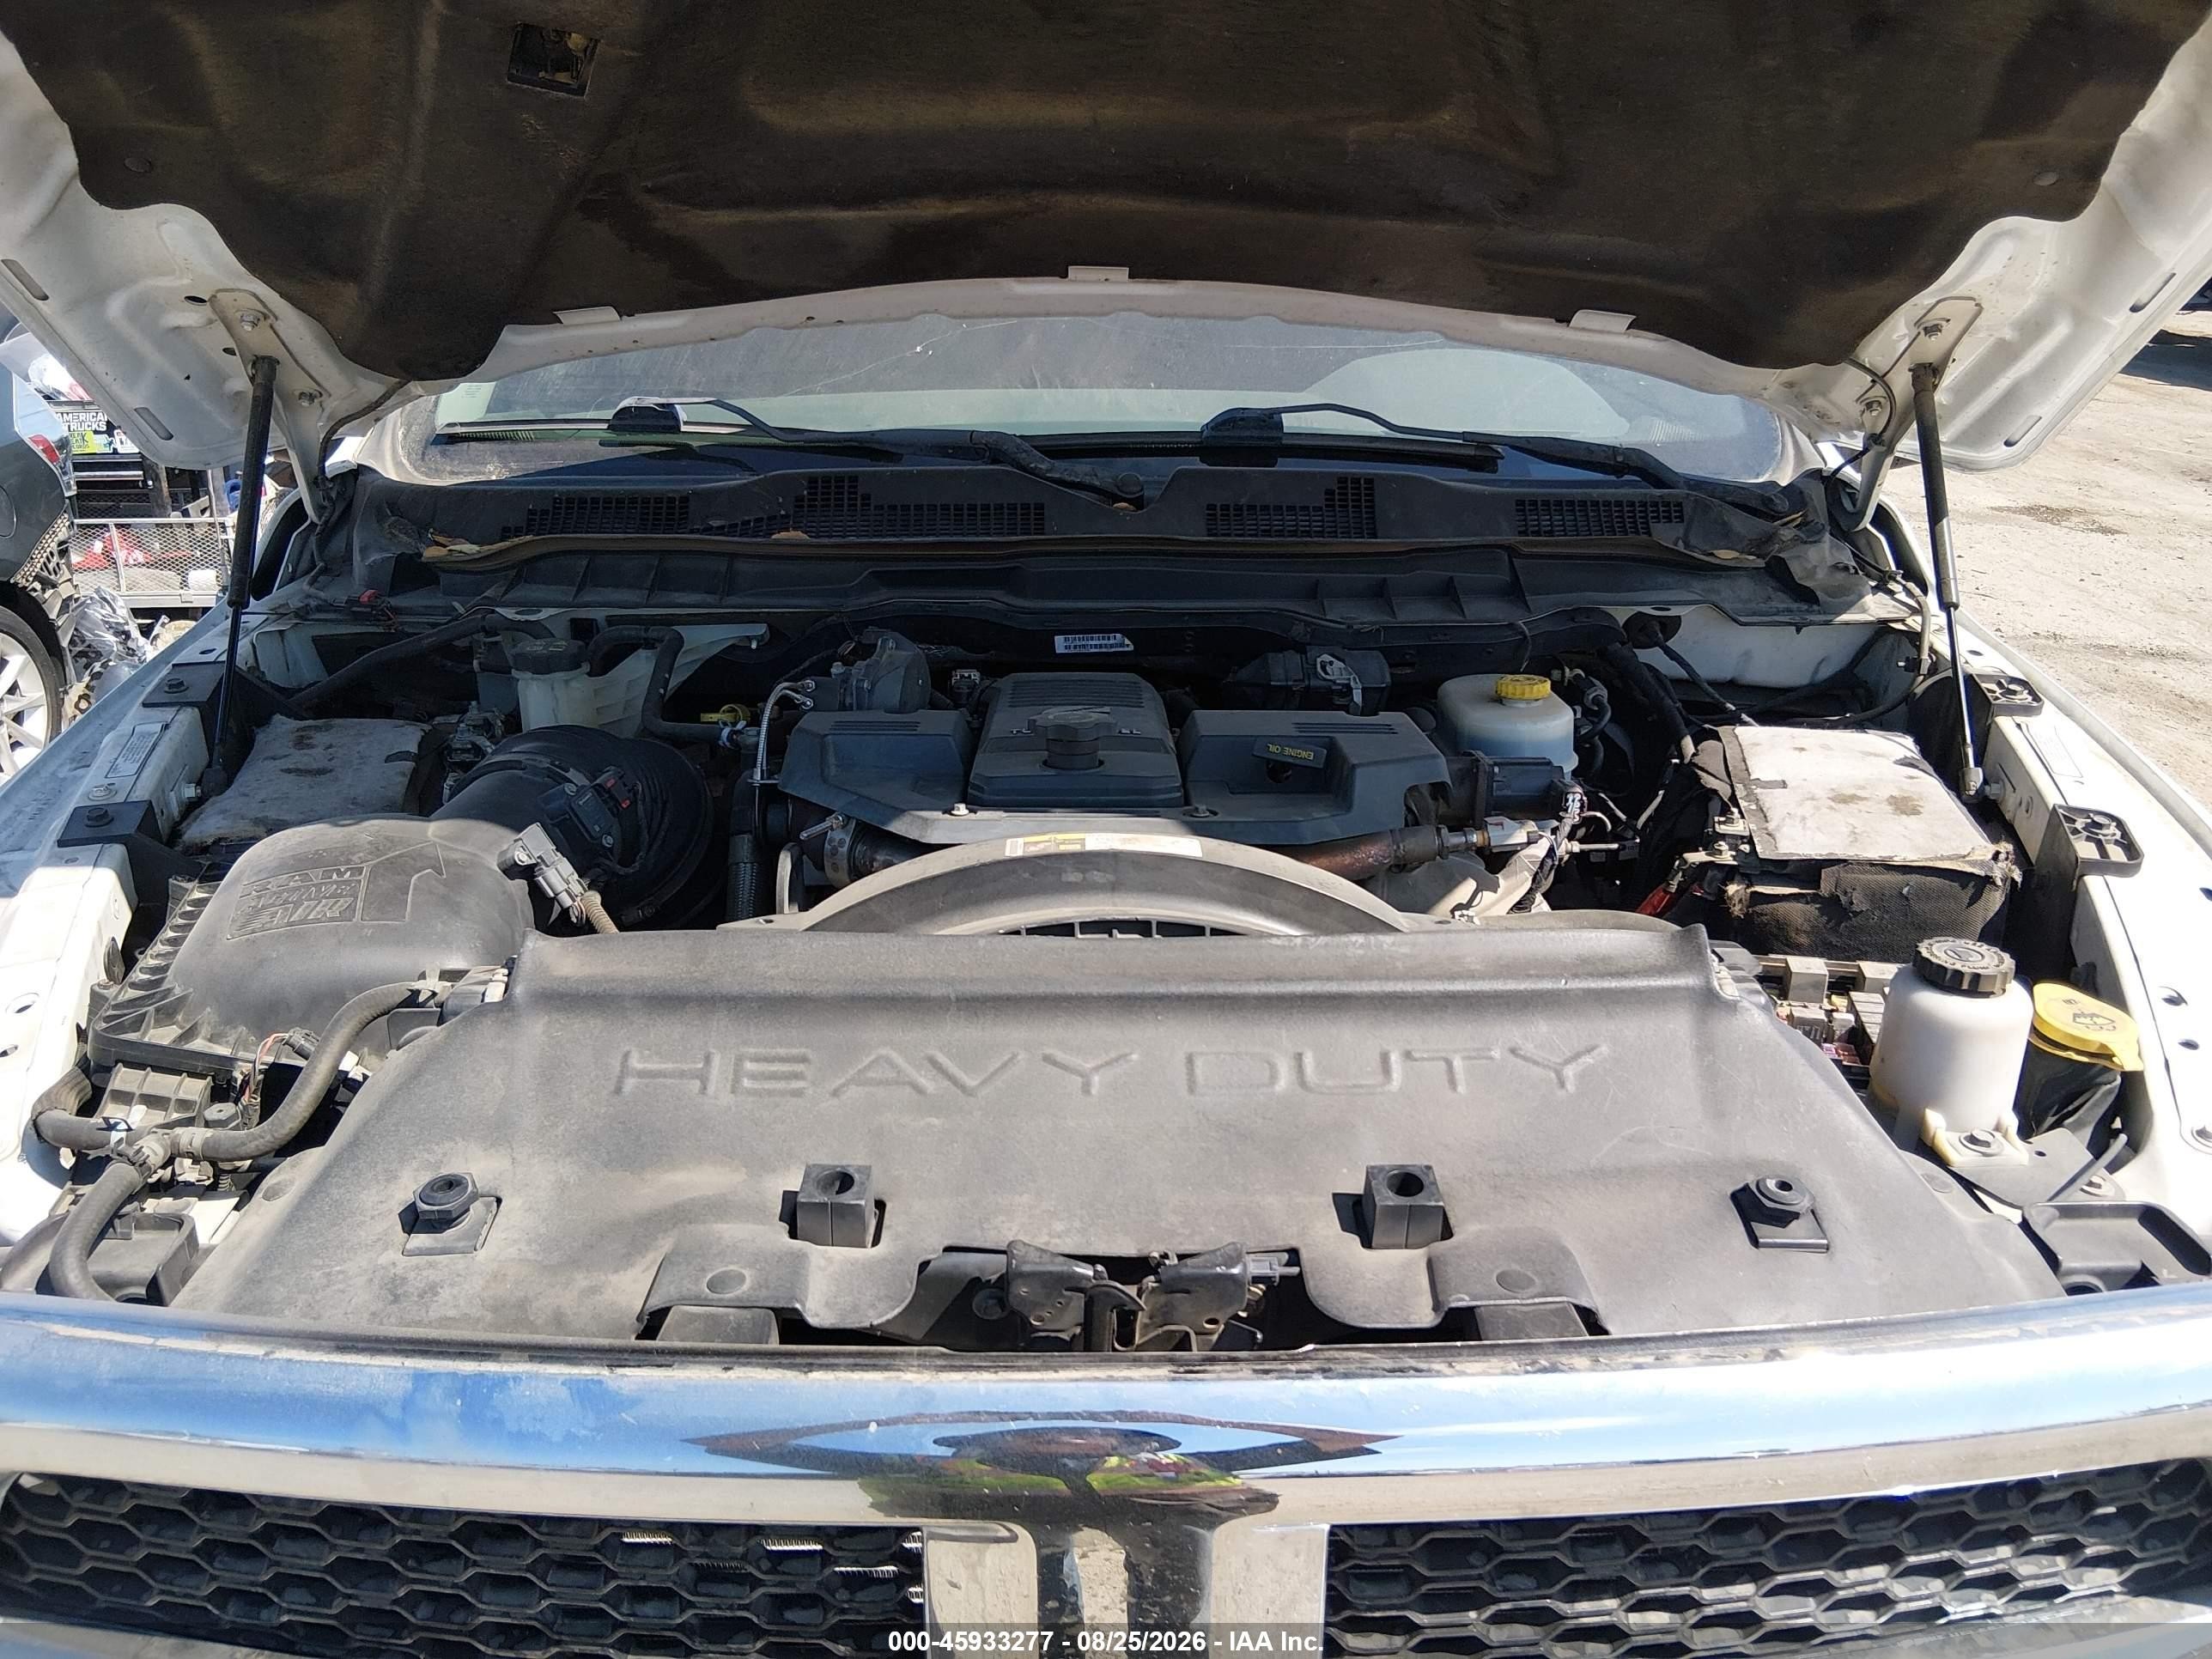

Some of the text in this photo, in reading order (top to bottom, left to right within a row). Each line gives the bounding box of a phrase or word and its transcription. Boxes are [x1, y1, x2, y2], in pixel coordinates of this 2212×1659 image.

[62, 421, 107, 431] TRUCKS
[1267, 743, 1315, 761] ENGINE OIL
[240, 866, 364, 899] RAM
[613, 1046, 1611, 1097] HEAVY DUTY
